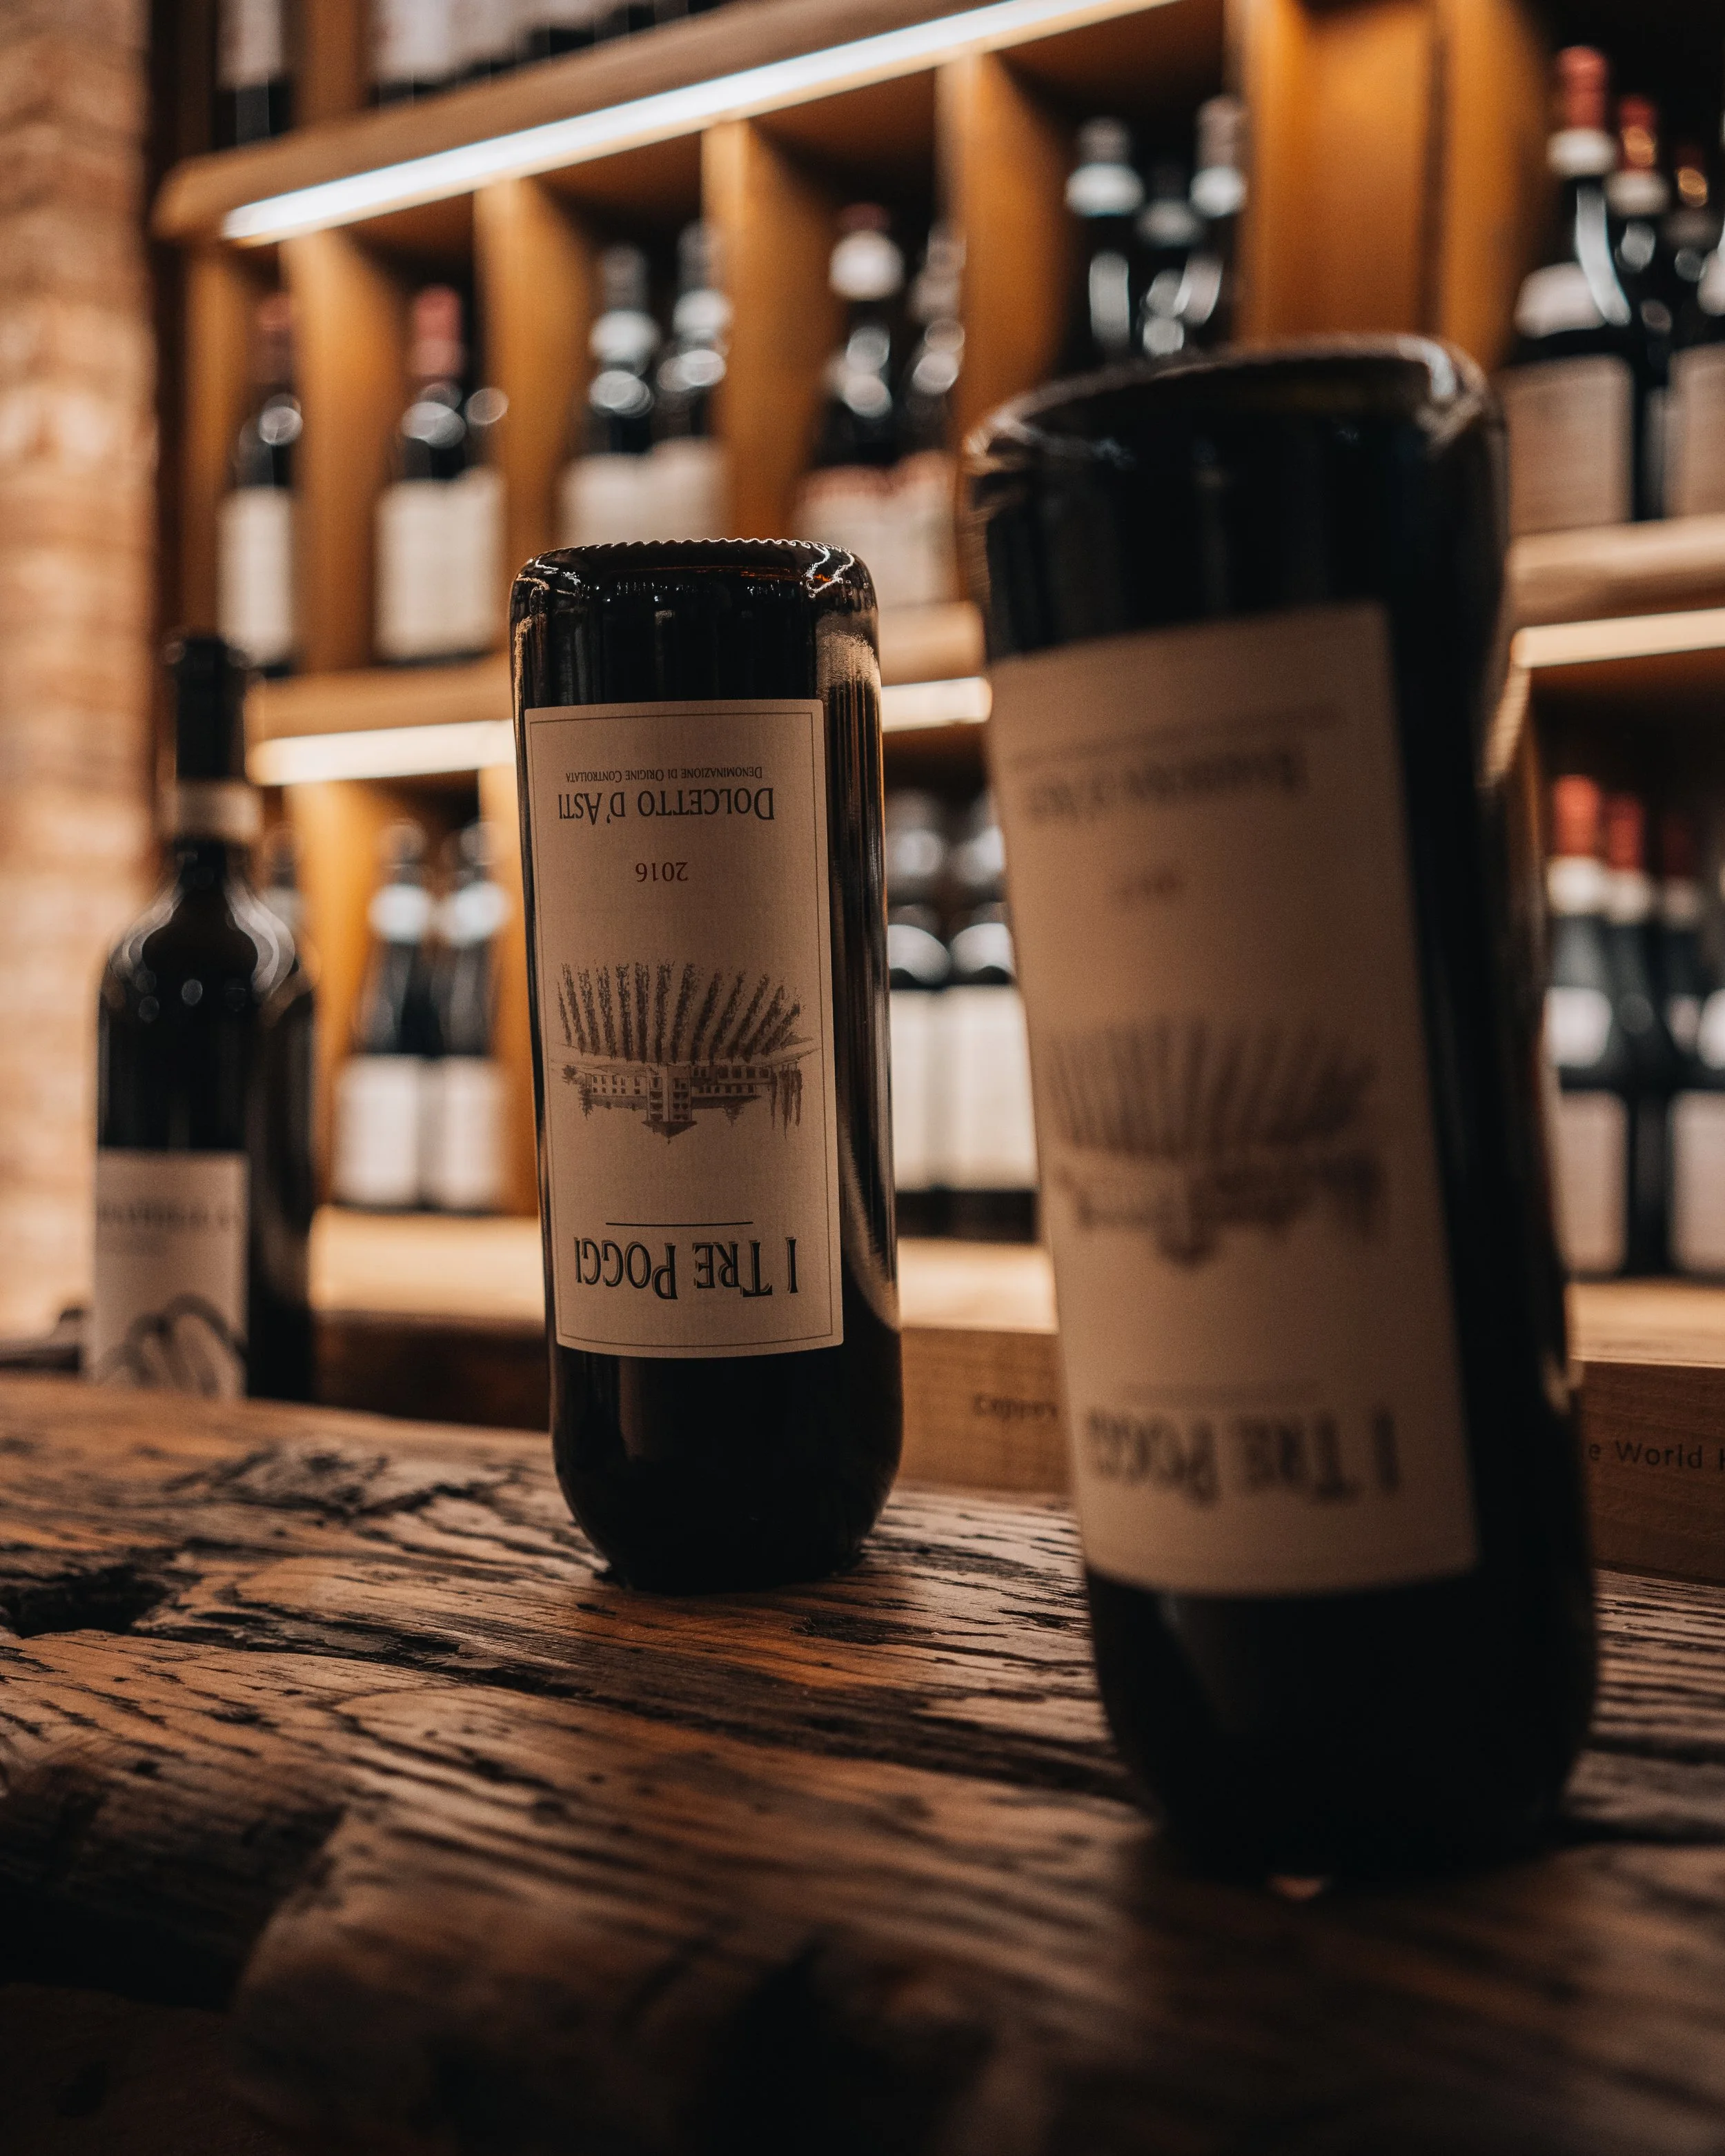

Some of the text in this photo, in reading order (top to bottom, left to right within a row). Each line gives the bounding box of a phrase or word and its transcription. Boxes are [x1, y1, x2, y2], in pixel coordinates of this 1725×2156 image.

[638, 787, 775, 820] DOLCETTO
[635, 862, 689, 882] 2016
[573, 1236, 799, 1300] I TRE POGGI
[1615, 1439, 1703, 1470] World
